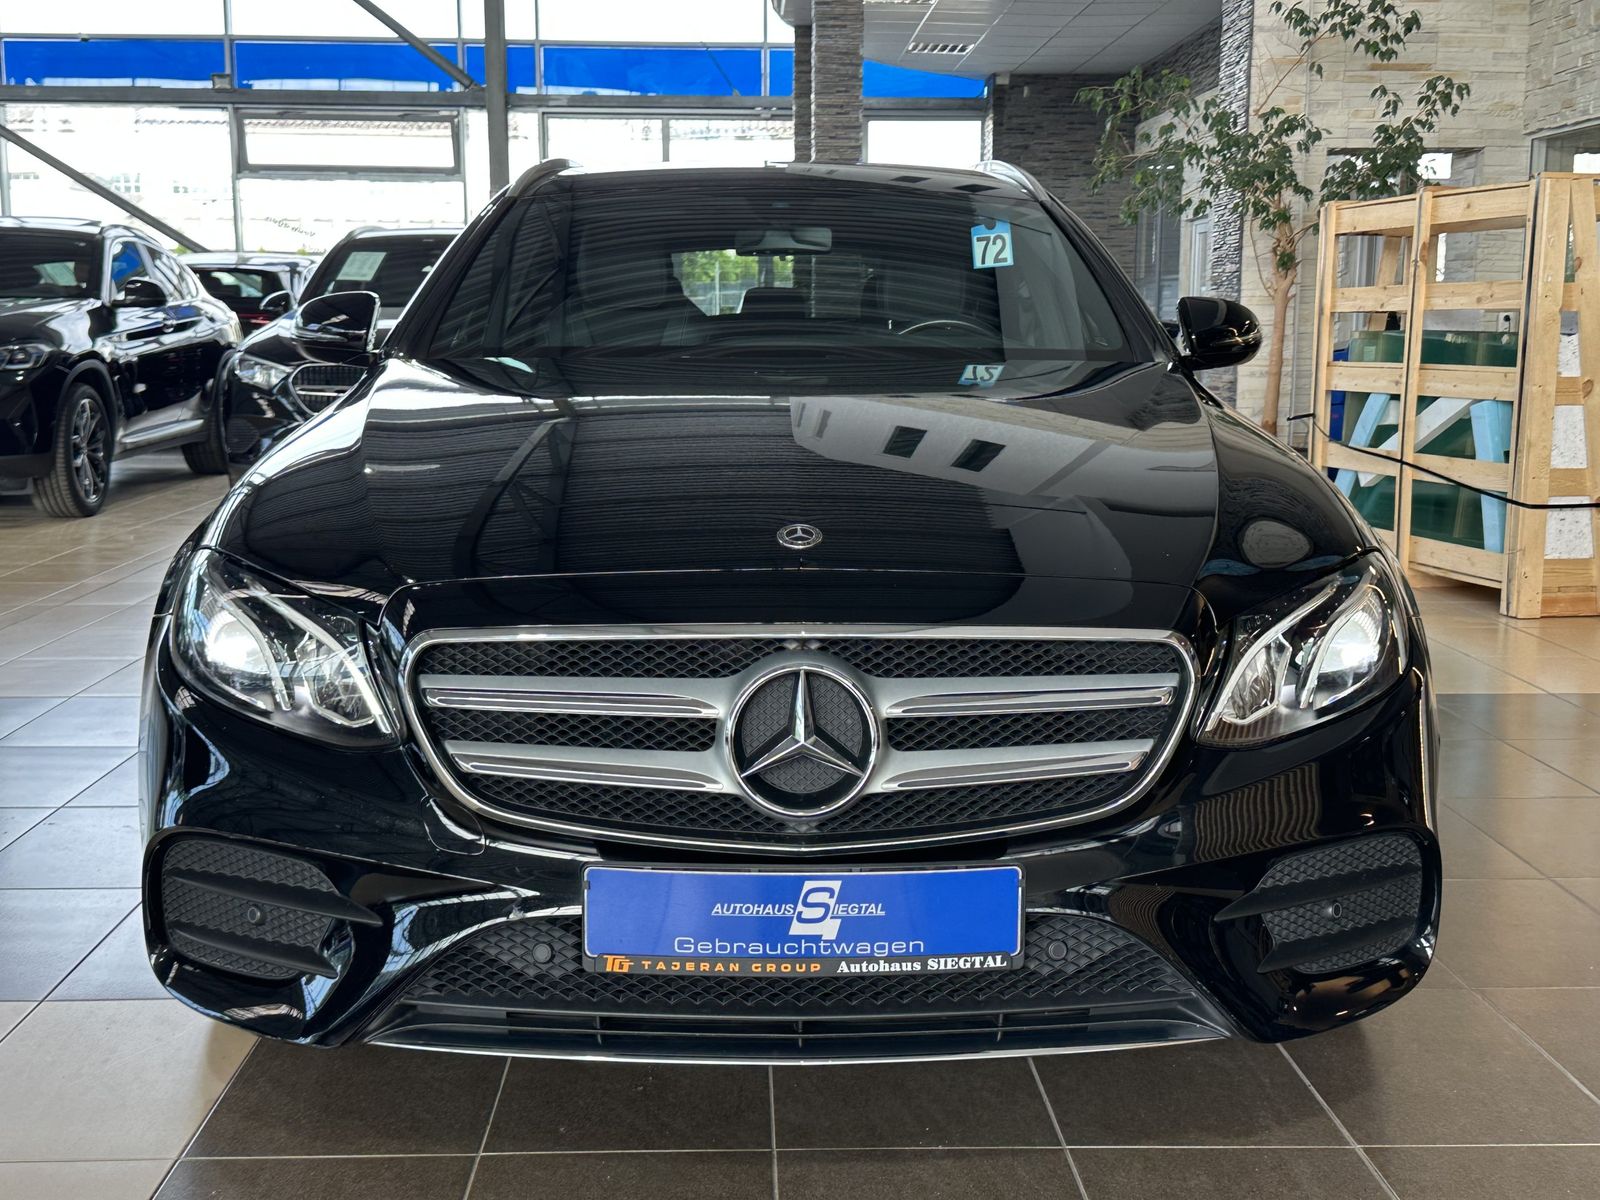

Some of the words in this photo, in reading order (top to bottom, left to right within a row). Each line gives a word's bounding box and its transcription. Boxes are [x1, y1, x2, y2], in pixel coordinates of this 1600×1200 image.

[975, 233, 1009, 265] 72
[711, 903, 795, 916] AUTOHAUS
[674, 937, 924, 957] Gebrauchtwagen
[641, 961, 740, 972] TAJERAN
[751, 963, 821, 973] GROUP
[837, 960, 921, 973] Autohaus
[927, 955, 1007, 970] SIEGTAL
